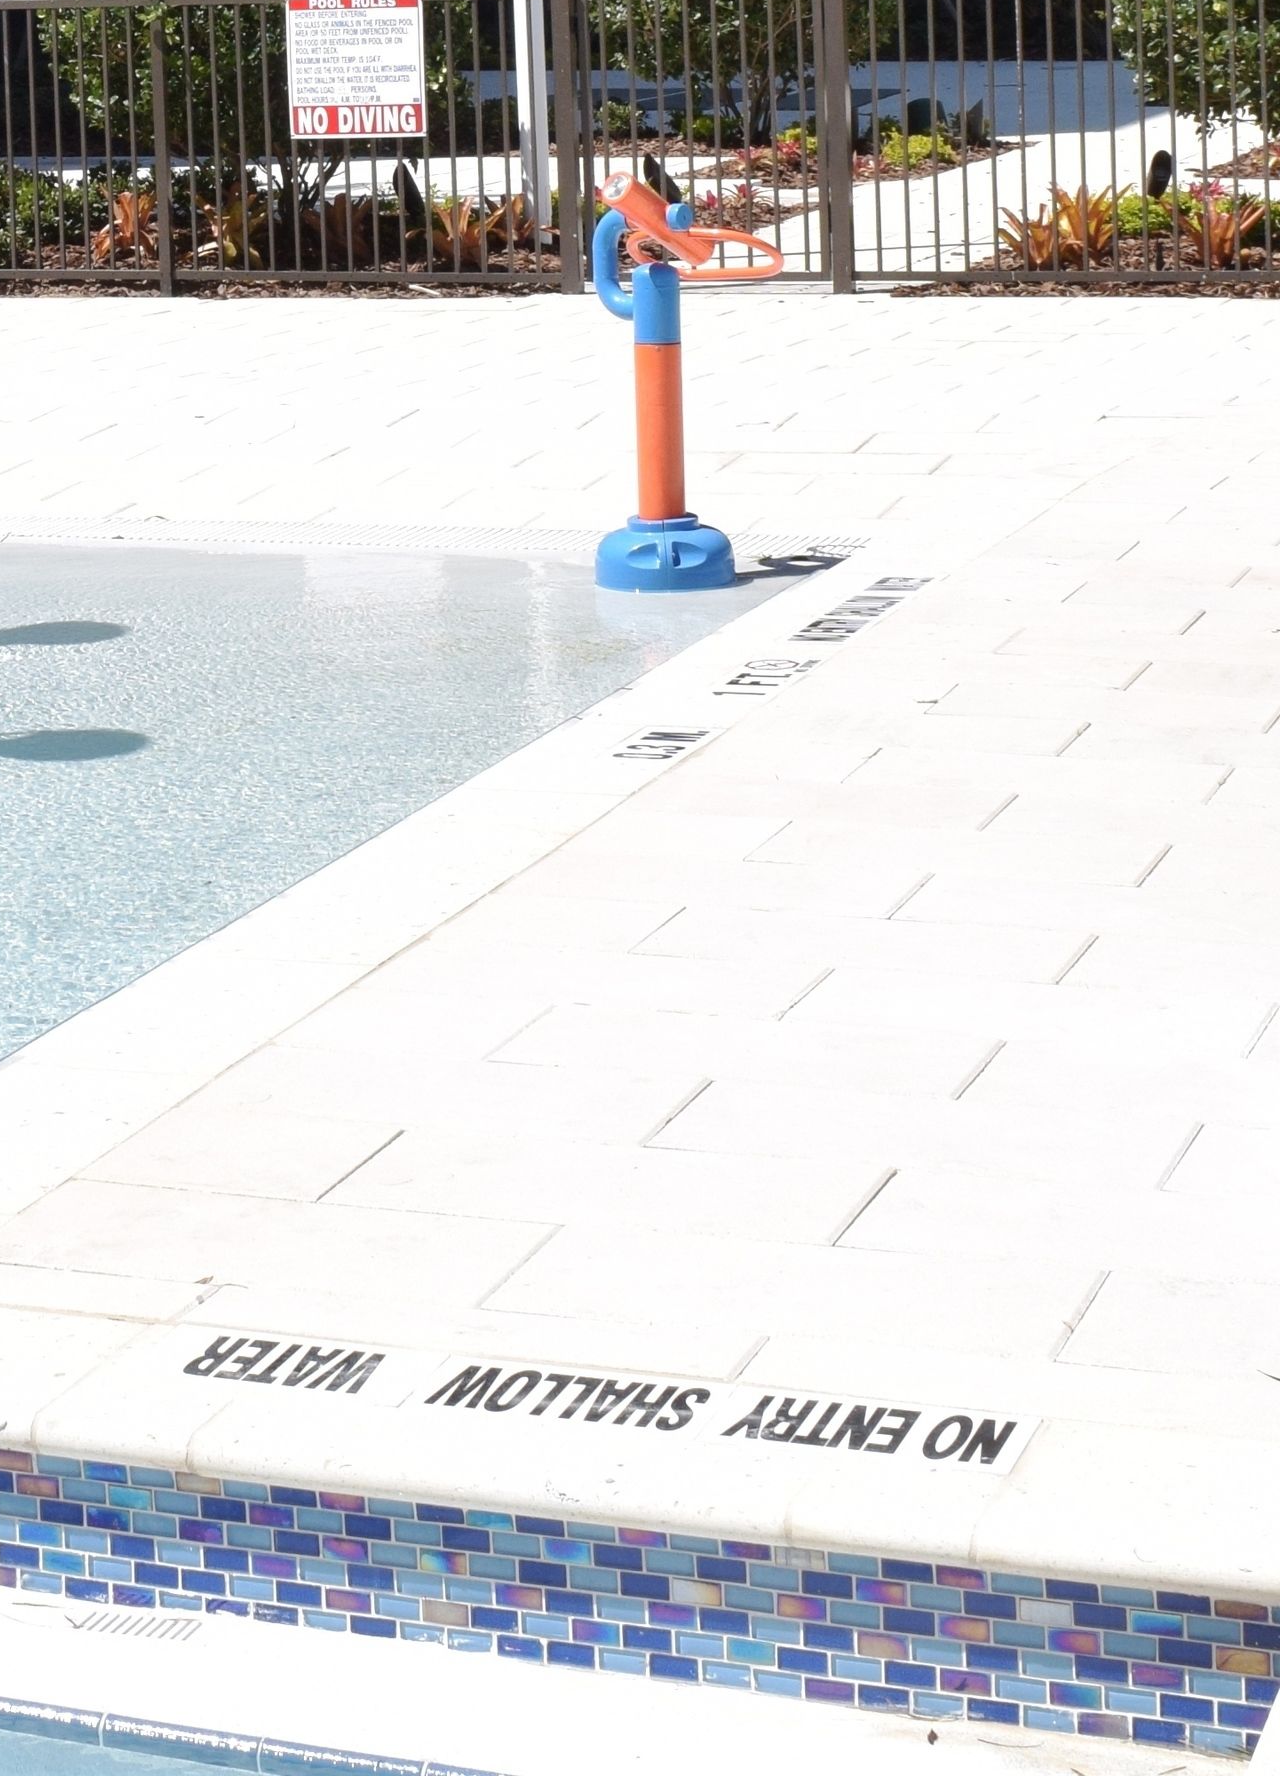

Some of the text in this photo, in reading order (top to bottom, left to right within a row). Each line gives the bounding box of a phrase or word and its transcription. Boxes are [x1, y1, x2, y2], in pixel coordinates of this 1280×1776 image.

[399, 18, 413, 26] POOL
[369, 37, 383, 45] POOL
[297, 105, 417, 134] NO DIVING
[612, 744, 686, 760] 0.3
[182, 1334, 1018, 1466] NO ENTRY SHALLOW WATER
